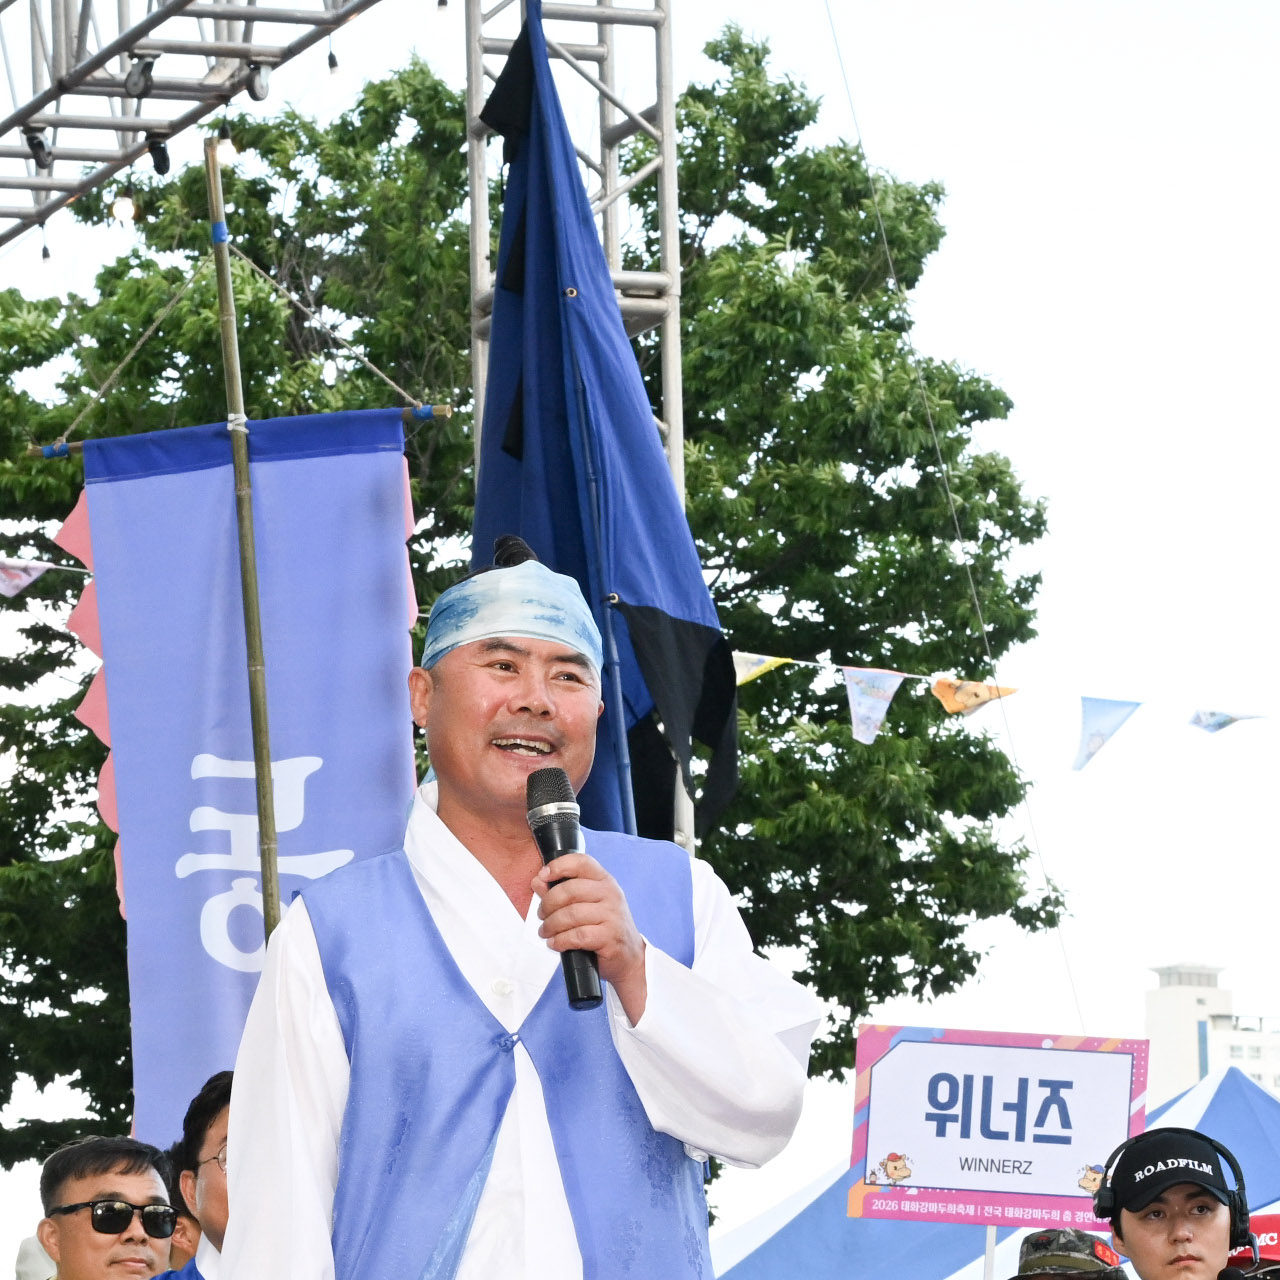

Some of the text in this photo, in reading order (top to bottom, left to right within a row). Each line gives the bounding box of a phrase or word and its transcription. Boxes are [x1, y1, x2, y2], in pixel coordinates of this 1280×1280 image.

[924, 1072, 1073, 1145] 위너즈
[959, 1156, 1033, 1175] WINNERZ
[1134, 1158, 1214, 1183] ROADFILM
[872, 1199, 898, 1211] 2026
[901, 1200, 975, 1216] 태화강마두희축제
